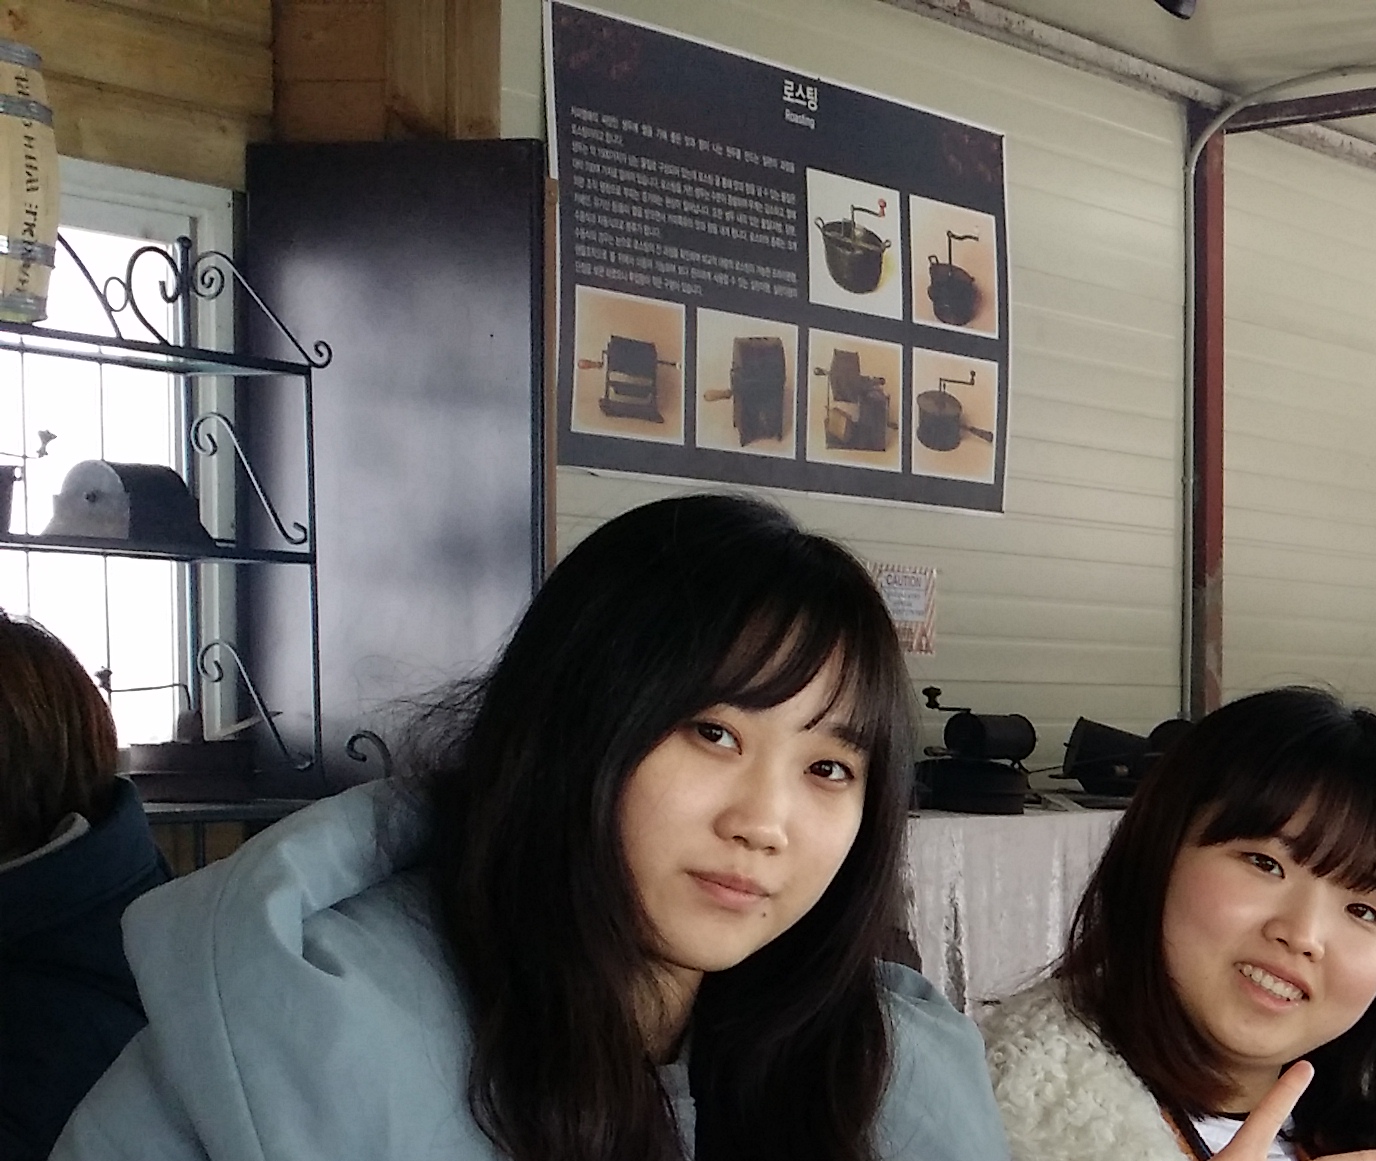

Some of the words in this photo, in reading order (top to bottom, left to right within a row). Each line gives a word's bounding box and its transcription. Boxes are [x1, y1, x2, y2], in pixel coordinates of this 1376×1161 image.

[782, 78, 819, 113] 로스팅
[784, 107, 816, 130] Roasting
[886, 573, 922, 588] CAUTION
